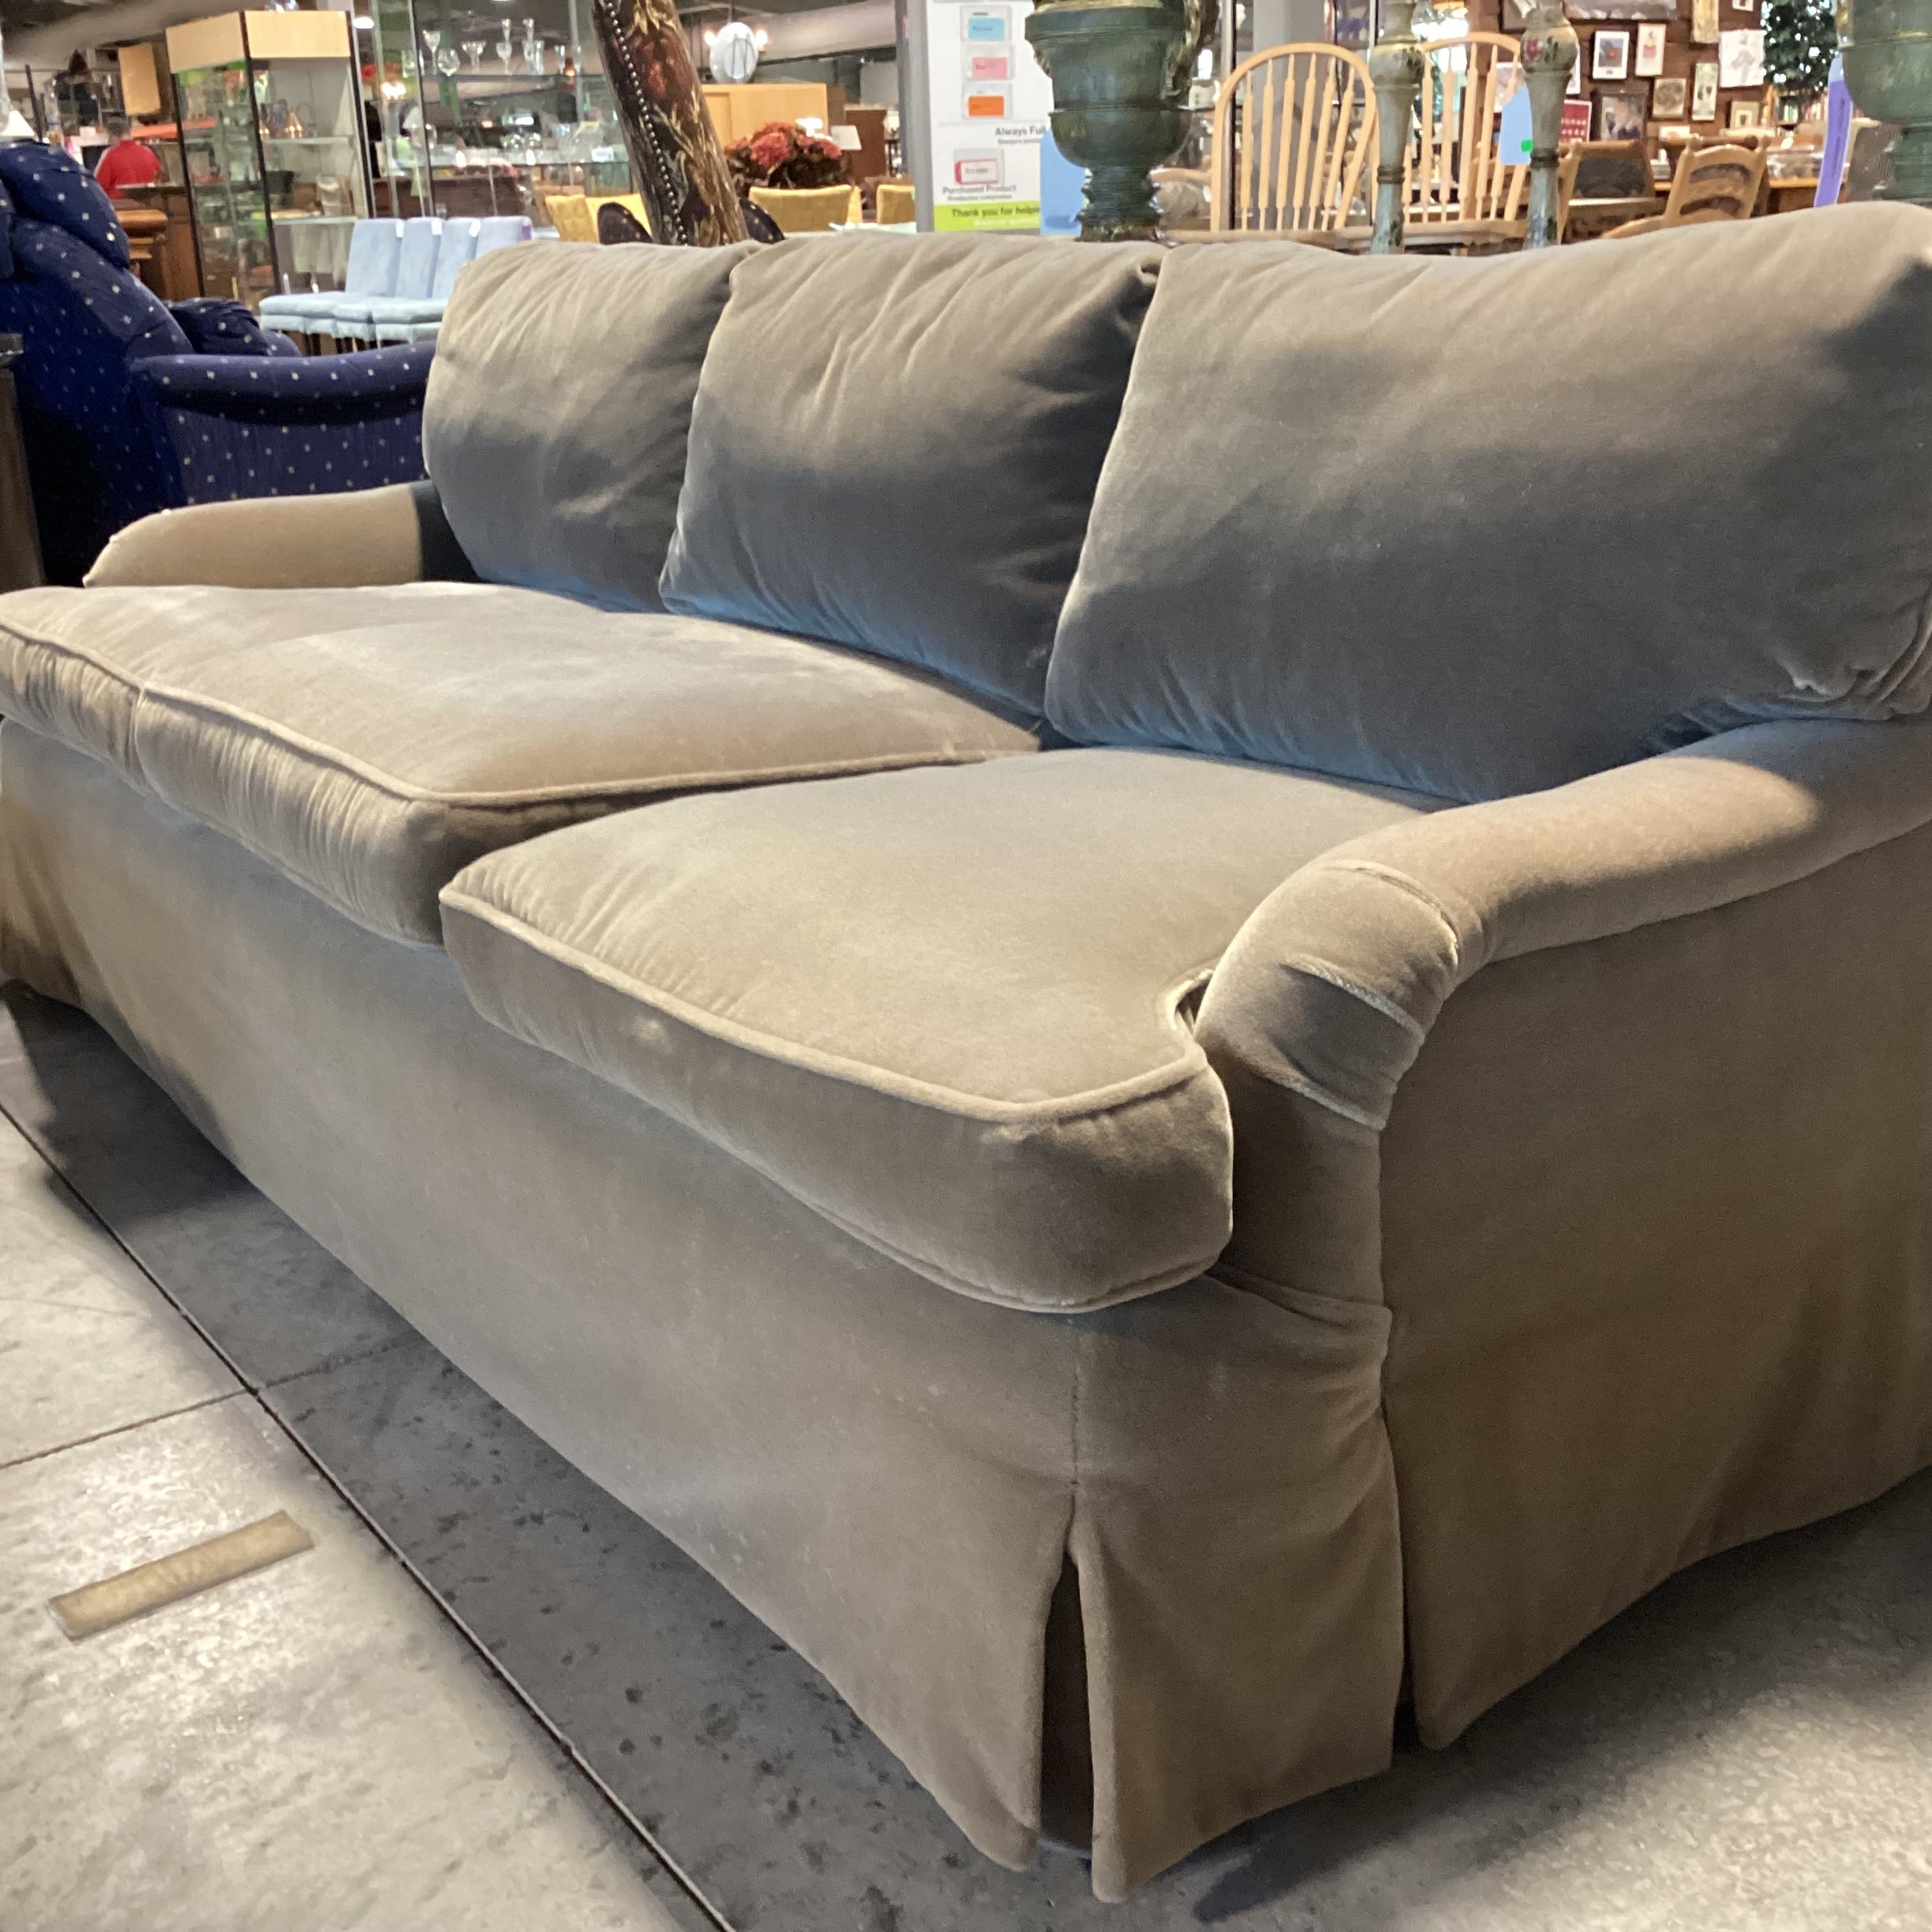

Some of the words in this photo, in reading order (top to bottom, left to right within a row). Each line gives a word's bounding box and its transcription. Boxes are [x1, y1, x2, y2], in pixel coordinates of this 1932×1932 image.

[994, 126, 1028, 136] Always
[952, 207, 979, 217] Thank
[982, 208, 998, 218] you
[1001, 206, 1013, 215] for
